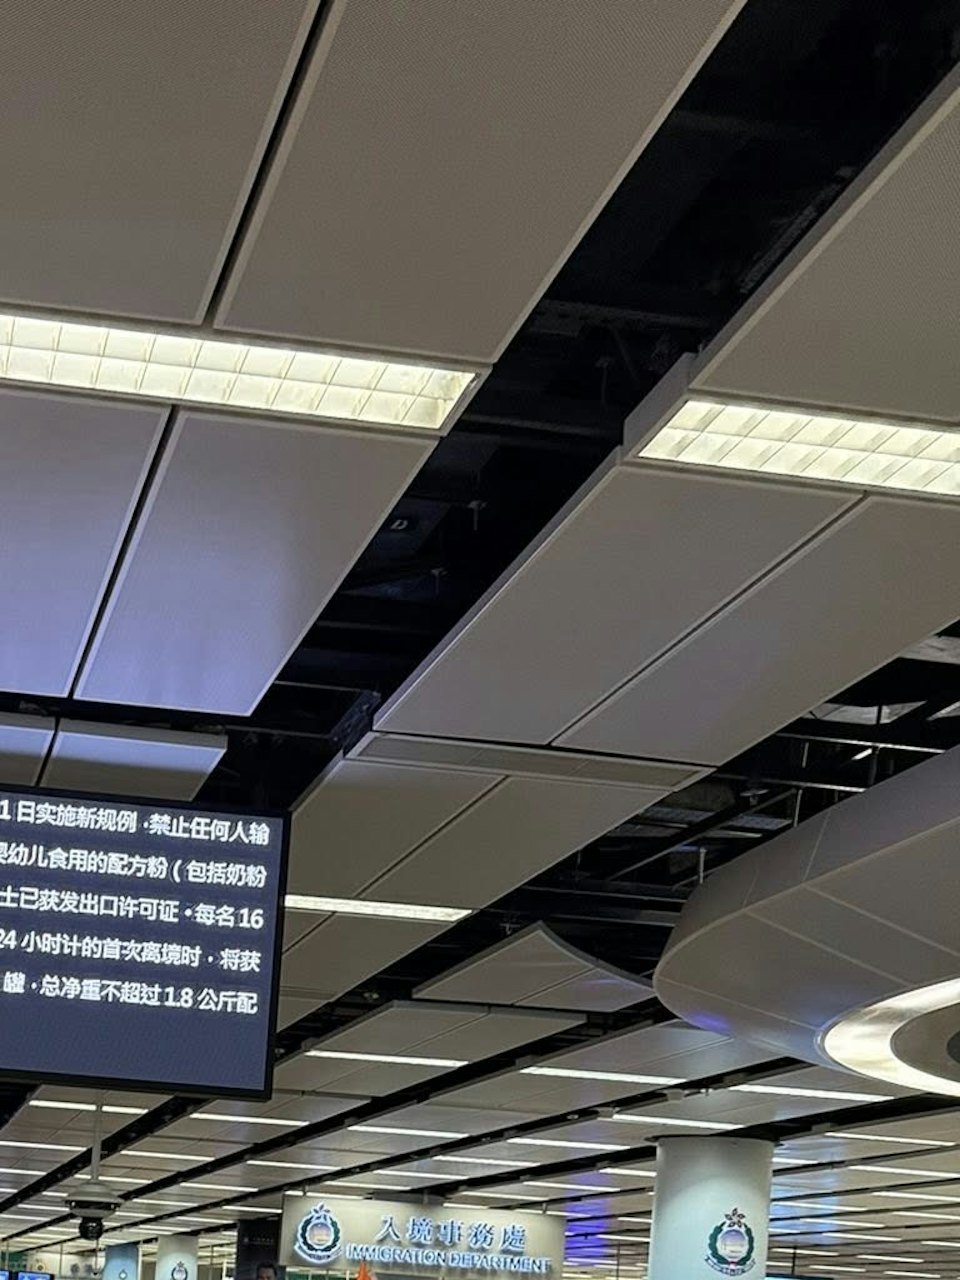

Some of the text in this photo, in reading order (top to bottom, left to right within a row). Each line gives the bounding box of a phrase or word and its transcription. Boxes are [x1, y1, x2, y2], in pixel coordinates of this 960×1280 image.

[374, 1215, 528, 1251] 入境事務處
[345, 1243, 552, 1274] IMMIGRATION DEPARTMENT
